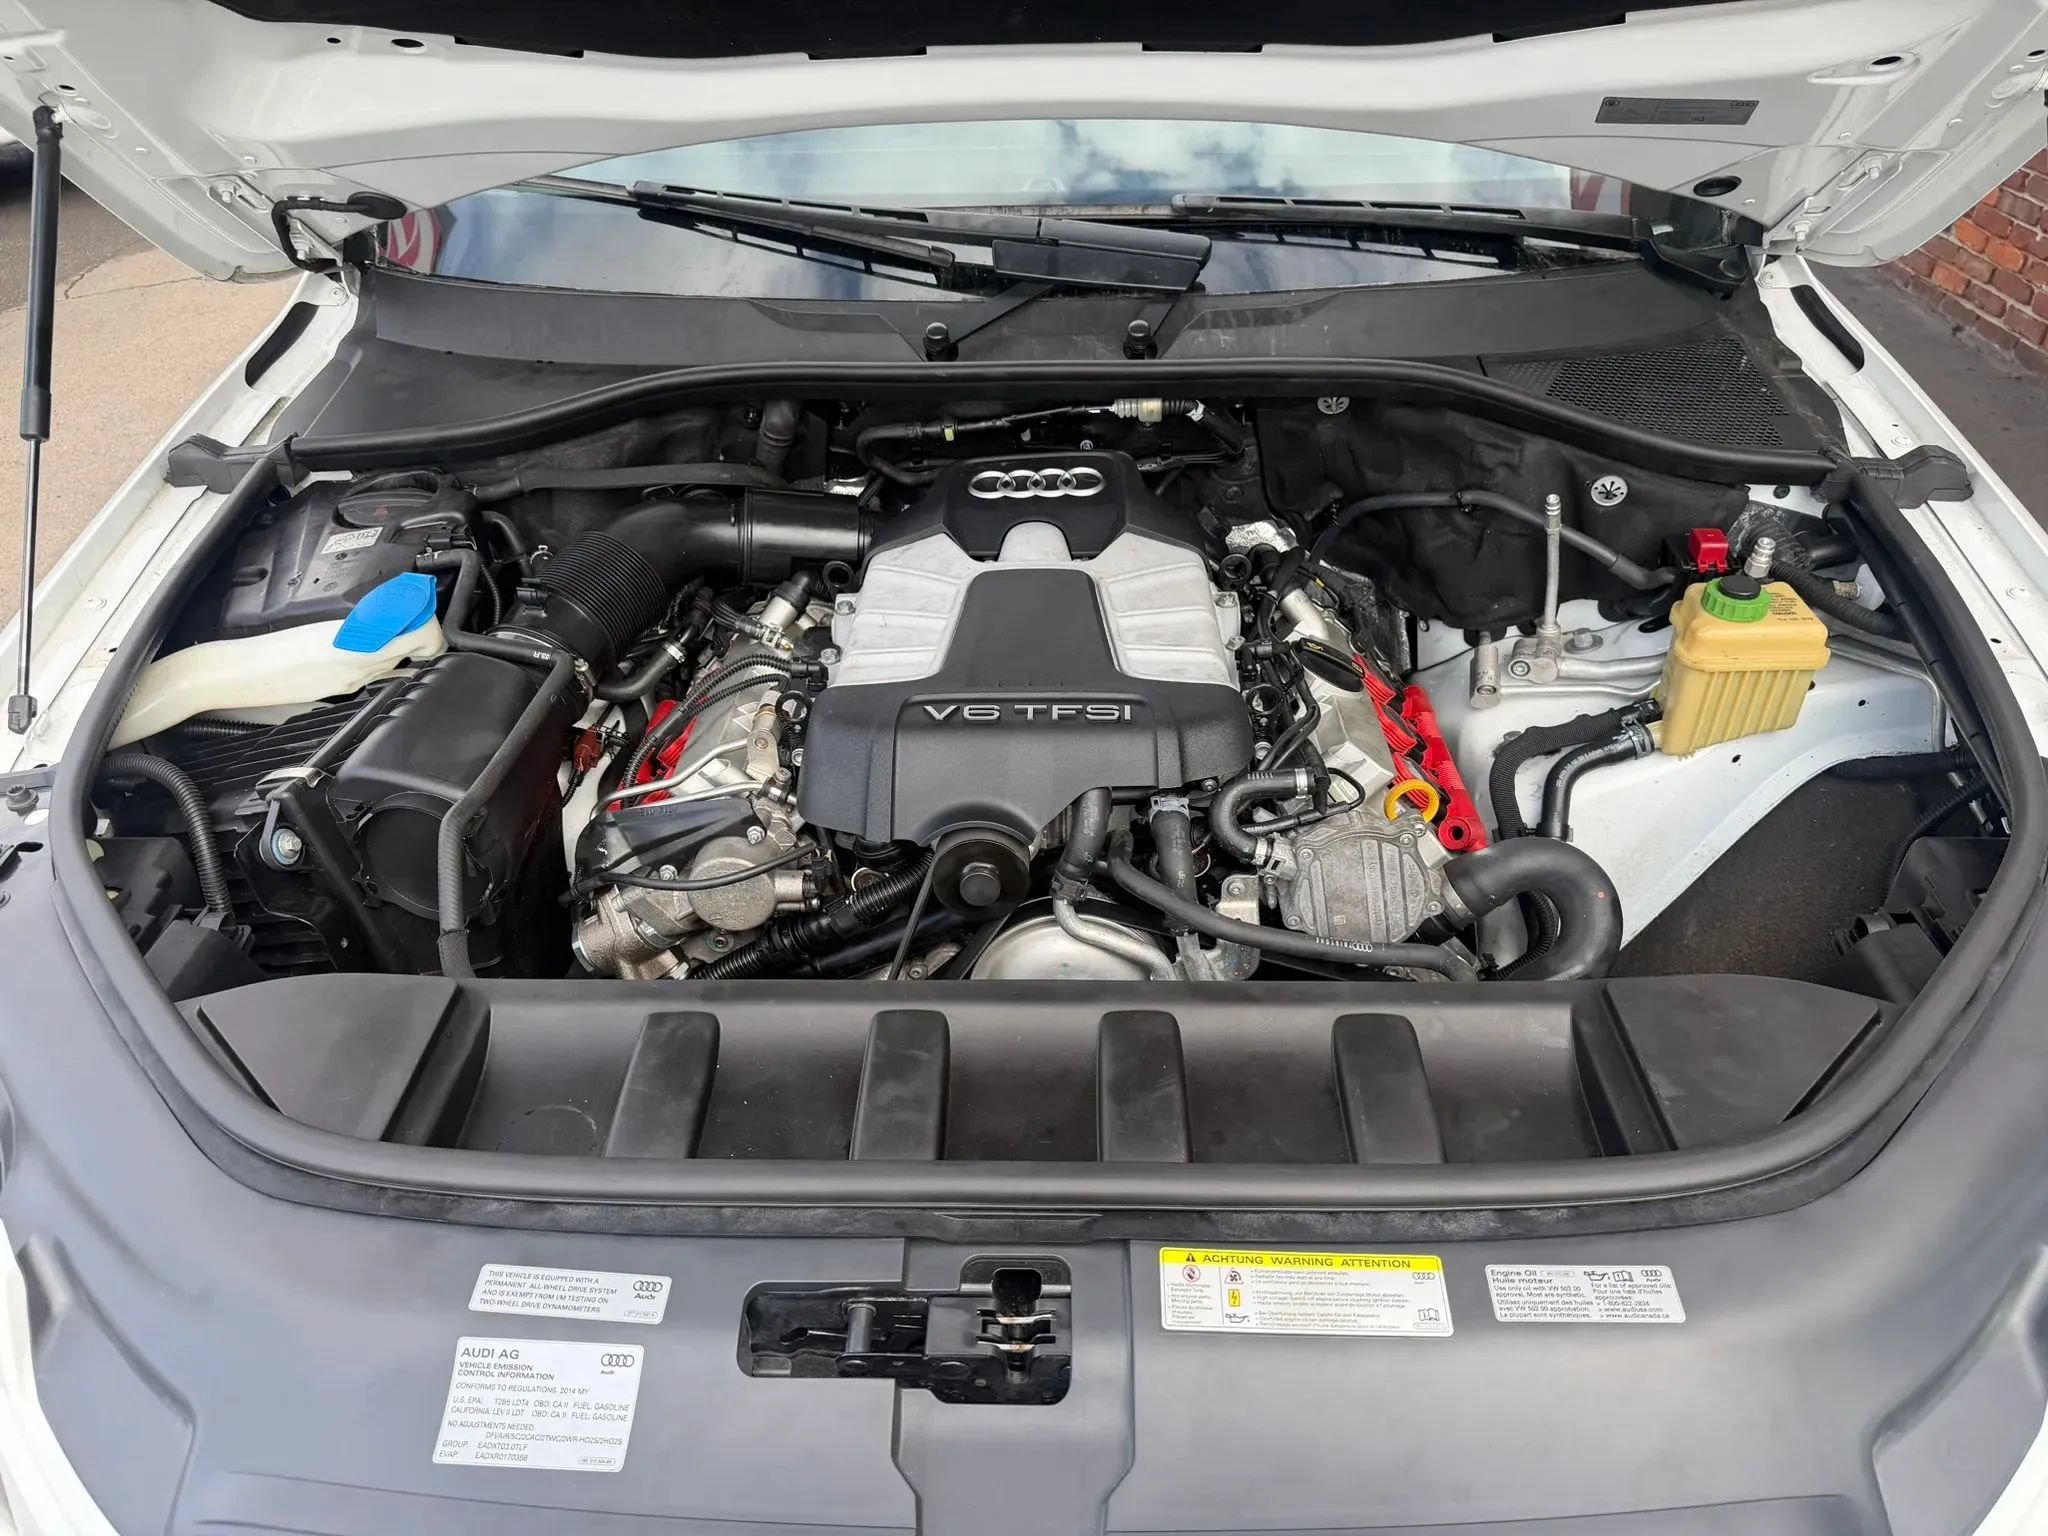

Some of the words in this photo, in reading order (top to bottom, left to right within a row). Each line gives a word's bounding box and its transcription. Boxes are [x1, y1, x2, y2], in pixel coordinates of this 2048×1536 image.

[923, 704, 1001, 721] V6
[1014, 704, 1132, 721] TFSI
[1203, 1254, 1264, 1265] ACHTUNG
[1271, 1256, 1333, 1267] WARNING
[1341, 1258, 1411, 1269] ATTENTION
[505, 1271, 531, 1279] VEHICLE
[541, 1274, 574, 1282] EQUIPPED
[1490, 1269, 1521, 1277] Engine
[1525, 1269, 1537, 1277] Oil
[485, 1280, 527, 1289] PERMANENT
[529, 1283, 567, 1292] ALL-WHEEL
[567, 1285, 588, 1293] DRIVE
[588, 1287, 617, 1295] SYSTEM
[506, 1290, 534, 1298] EXEMPT
[567, 1294, 596, 1303] TESTING
[480, 1298, 520, 1307] TWO-WHEEL
[521, 1301, 541, 1309] DRIVE
[460, 1347, 495, 1358] AUDI
[498, 1349, 520, 1360] AG
[459, 1361, 492, 1370] VEHICLE
[493, 1363, 533, 1371] EMISSION
[457, 1369, 495, 1378] CONTROL
[497, 1371, 555, 1380] INFORMATION
[455, 1382, 496, 1391] CONFORMS
[578, 1387, 590, 1395] MY
[552, 1400, 562, 1408] CA
[594, 1402, 630, 1412] GASOLINE
[492, 1407, 505, 1416] LEV
[511, 1408, 525, 1417] LDT
[550, 1410, 560, 1418] CA
[592, 1412, 628, 1422] GASOLINE
[447, 1419, 458, 1427] NO
[459, 1420, 506, 1430] ADJUSTMENTS
